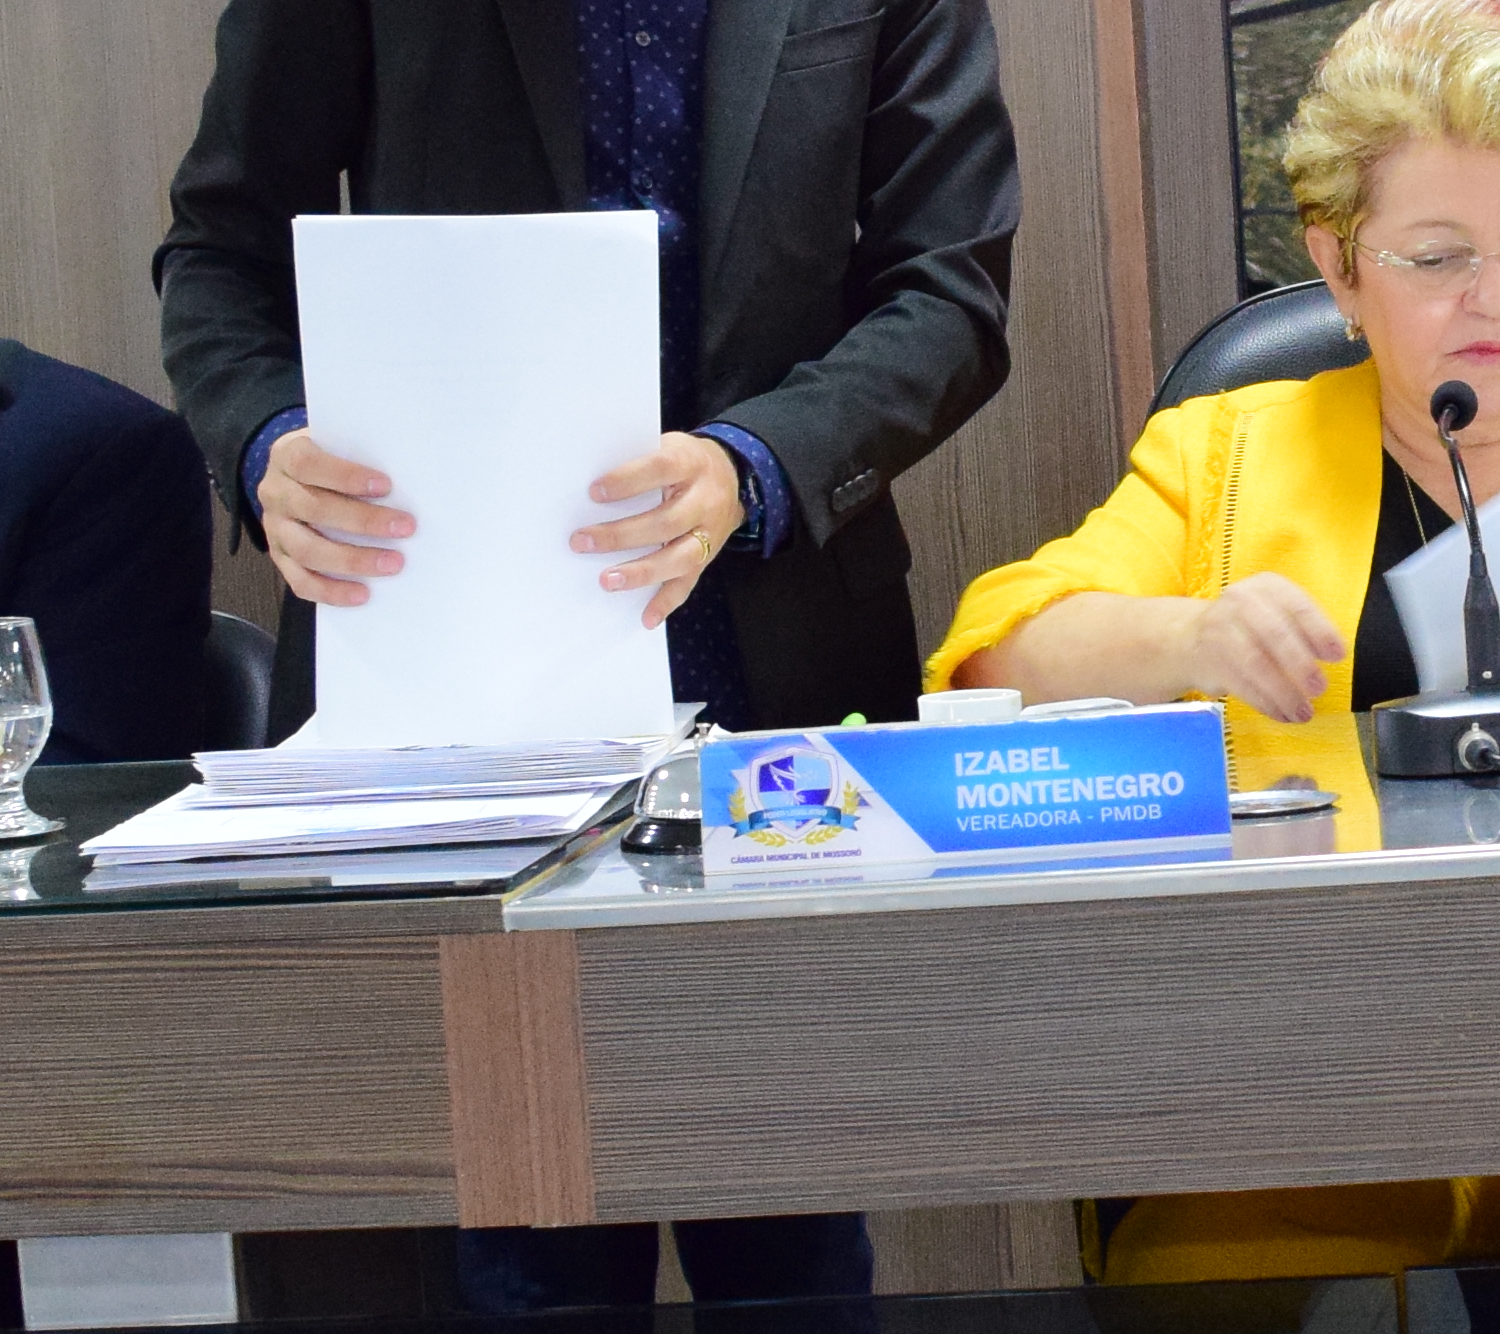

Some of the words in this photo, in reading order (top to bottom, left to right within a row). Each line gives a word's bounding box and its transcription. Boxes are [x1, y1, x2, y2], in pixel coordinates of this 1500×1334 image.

[955, 747, 1070, 777] IZABEL
[956, 771, 1185, 810] MONTENEGRO
[957, 809, 1081, 833] VEREADORA
[1101, 803, 1163, 823] PMDB
